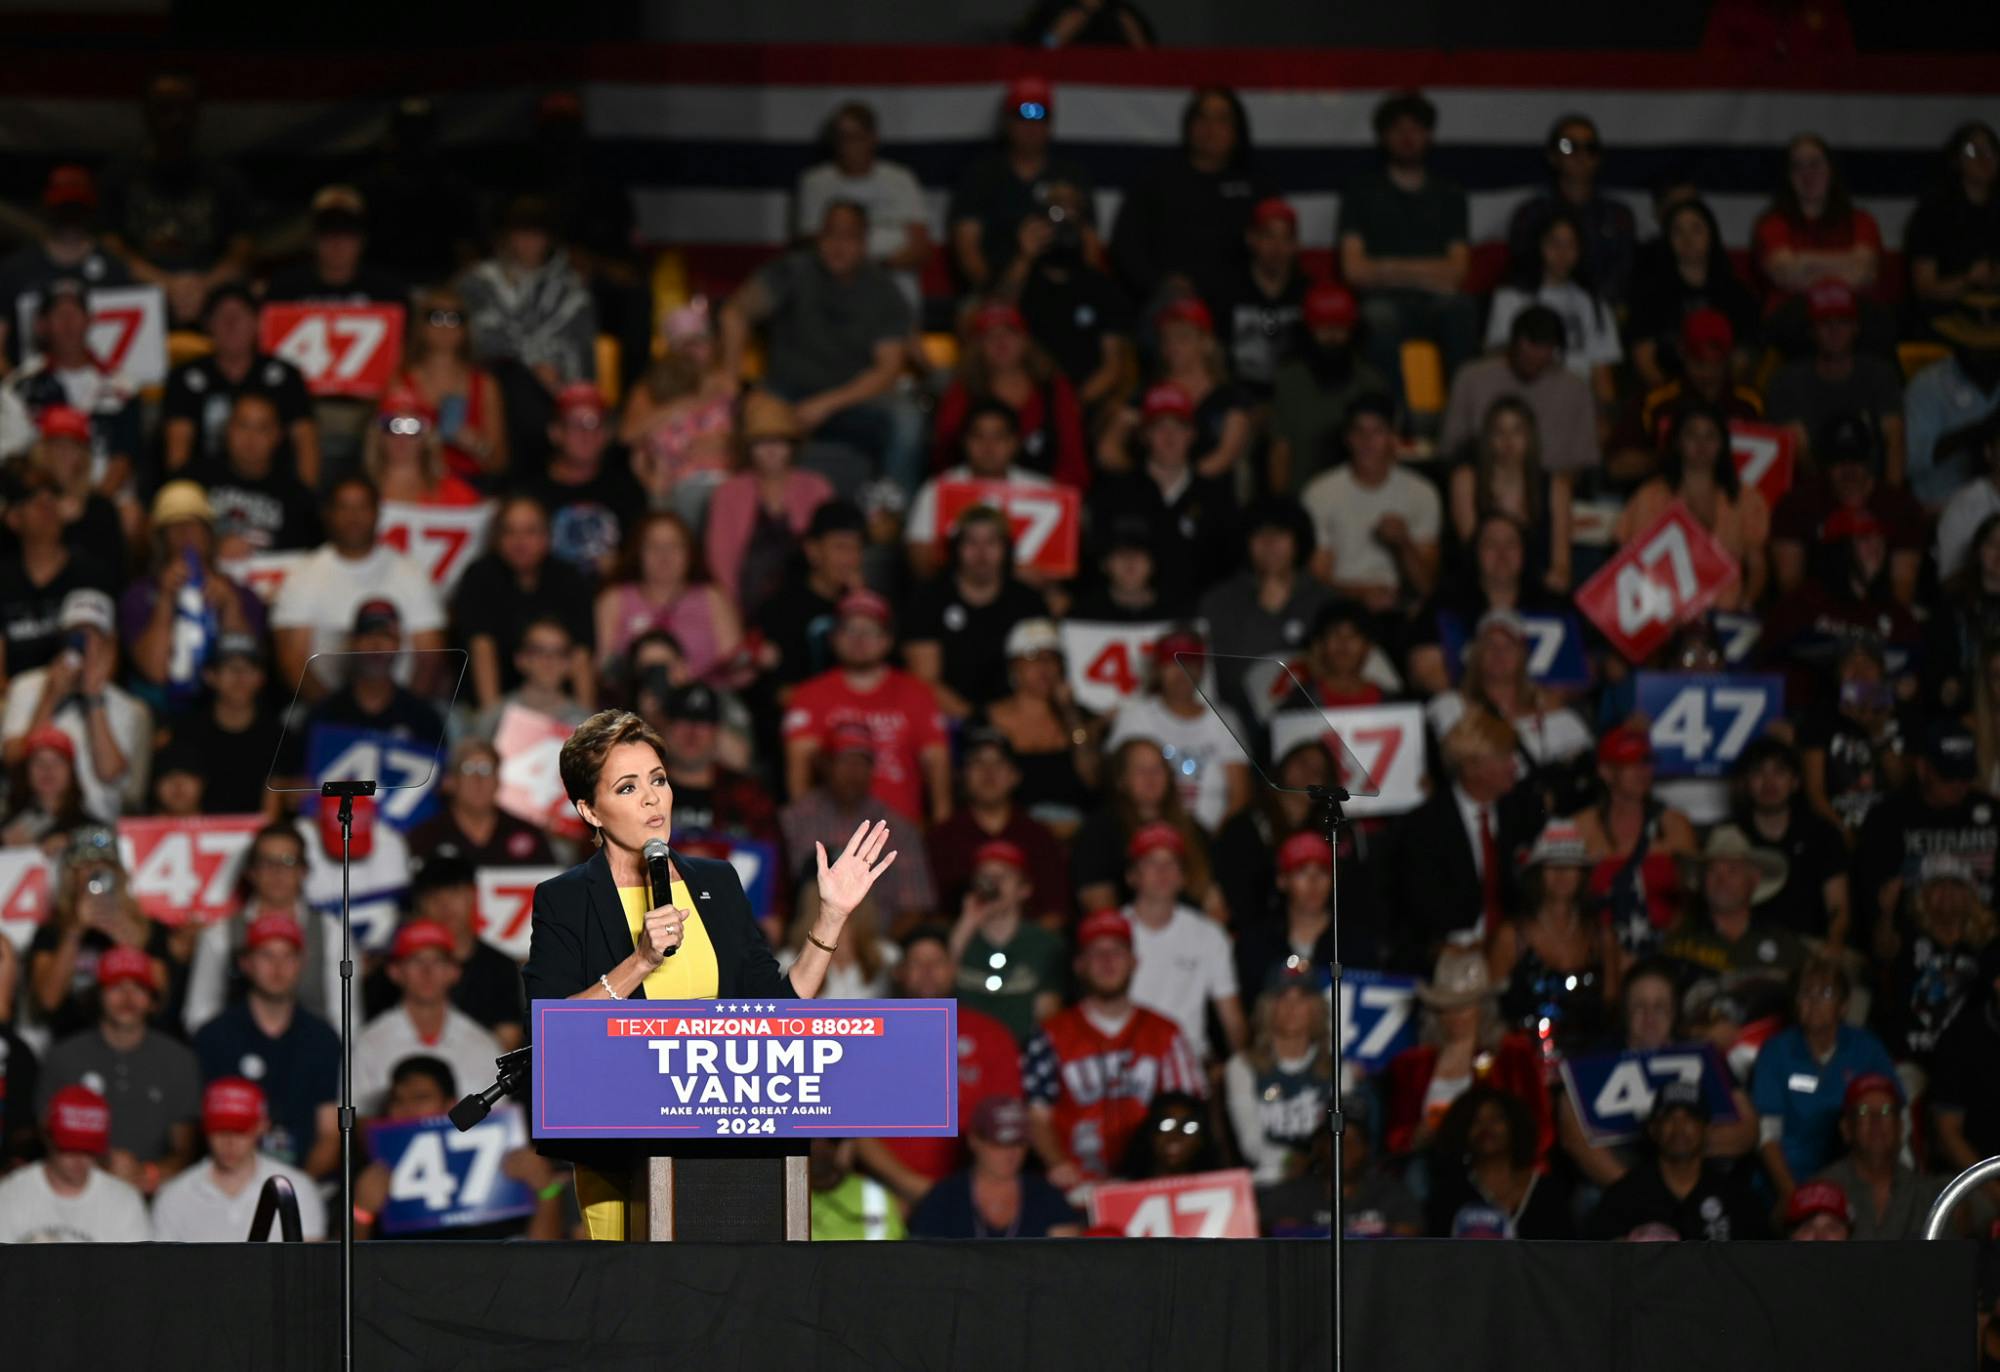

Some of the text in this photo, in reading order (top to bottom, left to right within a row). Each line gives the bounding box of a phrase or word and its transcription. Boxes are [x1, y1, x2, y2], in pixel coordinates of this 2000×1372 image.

[274, 314, 389, 379] 47
[1615, 520, 1699, 637] 47
[1649, 686, 1767, 762] 47
[128, 831, 256, 908] 47
[616, 1018, 875, 1035] TEXT ARIZONA TO 88022
[648, 1039, 844, 1075] TRUMP
[660, 1106, 832, 1116] MAKE AMERICA GREAT AGAIN!
[670, 1075, 821, 1104] VANCE
[716, 1118, 776, 1134] 2024
[390, 1123, 506, 1211] 47
